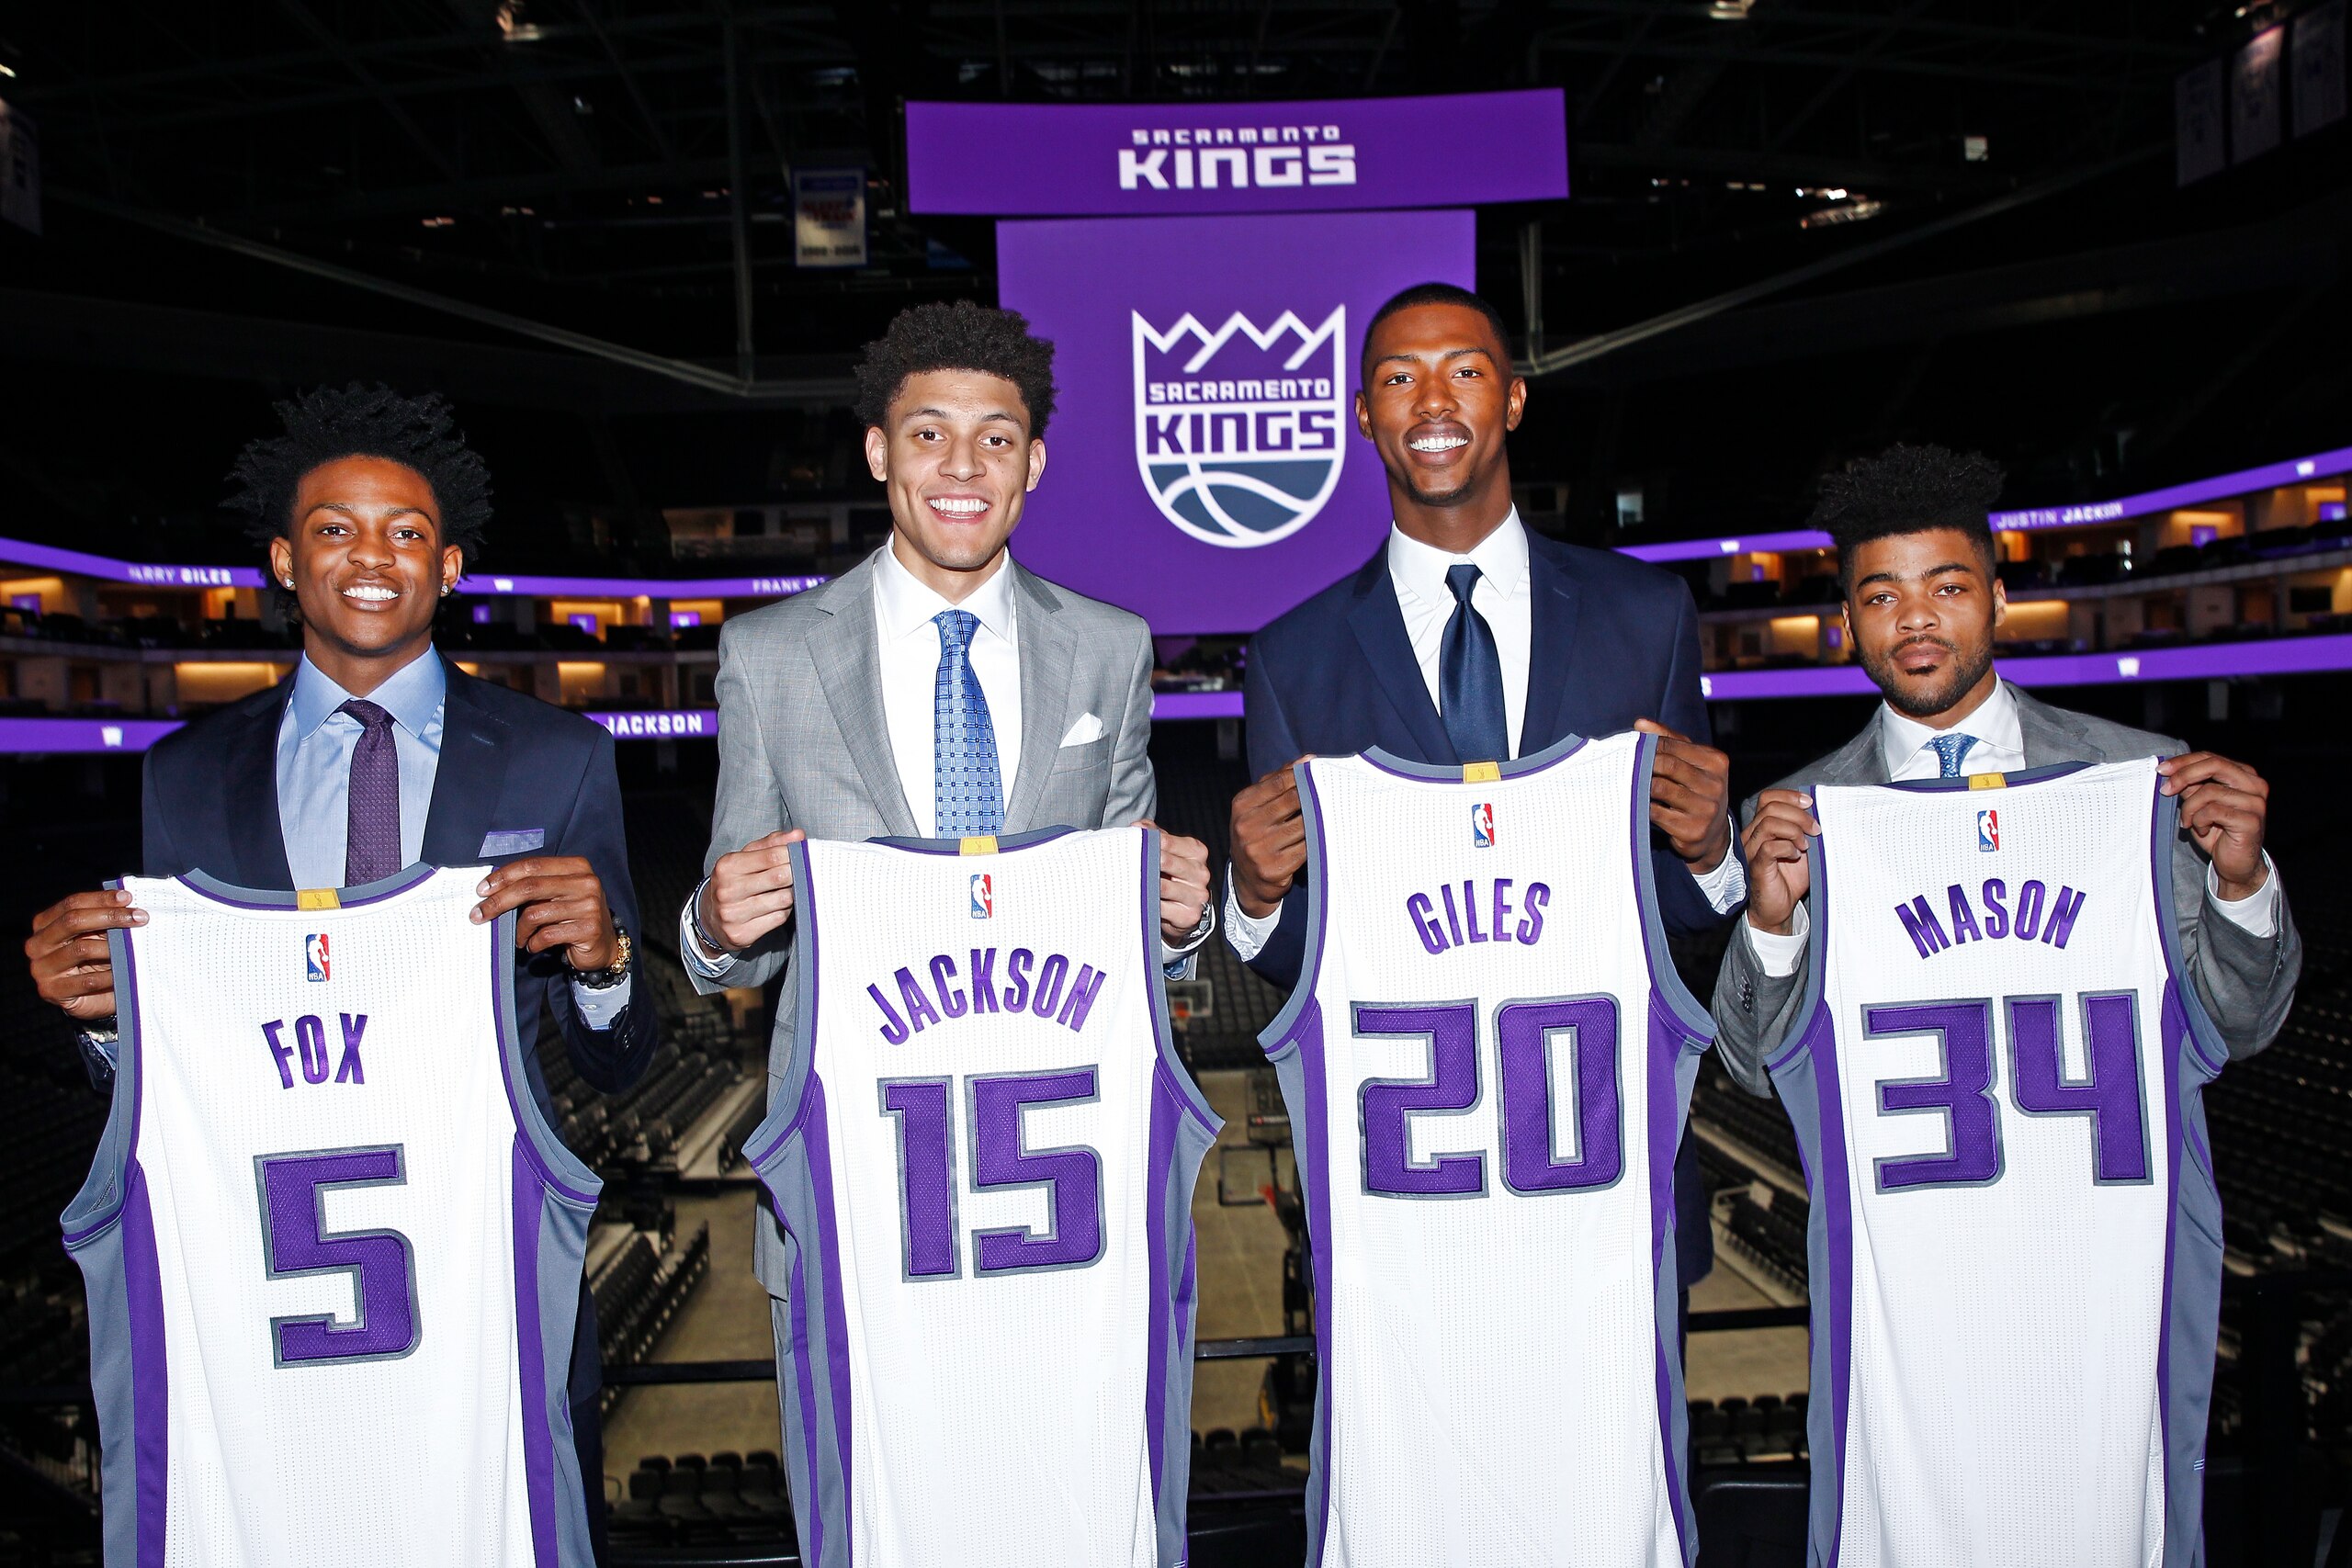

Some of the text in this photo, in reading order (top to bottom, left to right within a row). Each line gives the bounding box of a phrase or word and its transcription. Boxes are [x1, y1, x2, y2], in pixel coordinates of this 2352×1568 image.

[1132, 125, 1340, 145] SACRAMENTO
[1118, 144, 1357, 189] KINGS
[1148, 378, 1331, 402] SACRAMENTO
[1146, 411, 1335, 455] KINGS
[1996, 511, 2057, 529] JUSTIN
[180, 568, 232, 584] GILES
[605, 714, 703, 735] JACKSON
[1476, 839, 1488, 847] NBA
[972, 909, 987, 919] NBA
[1407, 878, 1550, 954] GILES
[1894, 878, 2086, 959] MASON
[309, 972, 324, 982] NBA
[866, 948, 1106, 1045] JACKSON
[261, 1012, 368, 1089] FOX
[1350, 992, 1625, 1201] 20
[1860, 988, 2154, 1194] 34
[877, 1064, 1107, 1283] 15
[253, 1144, 422, 1370] 5
